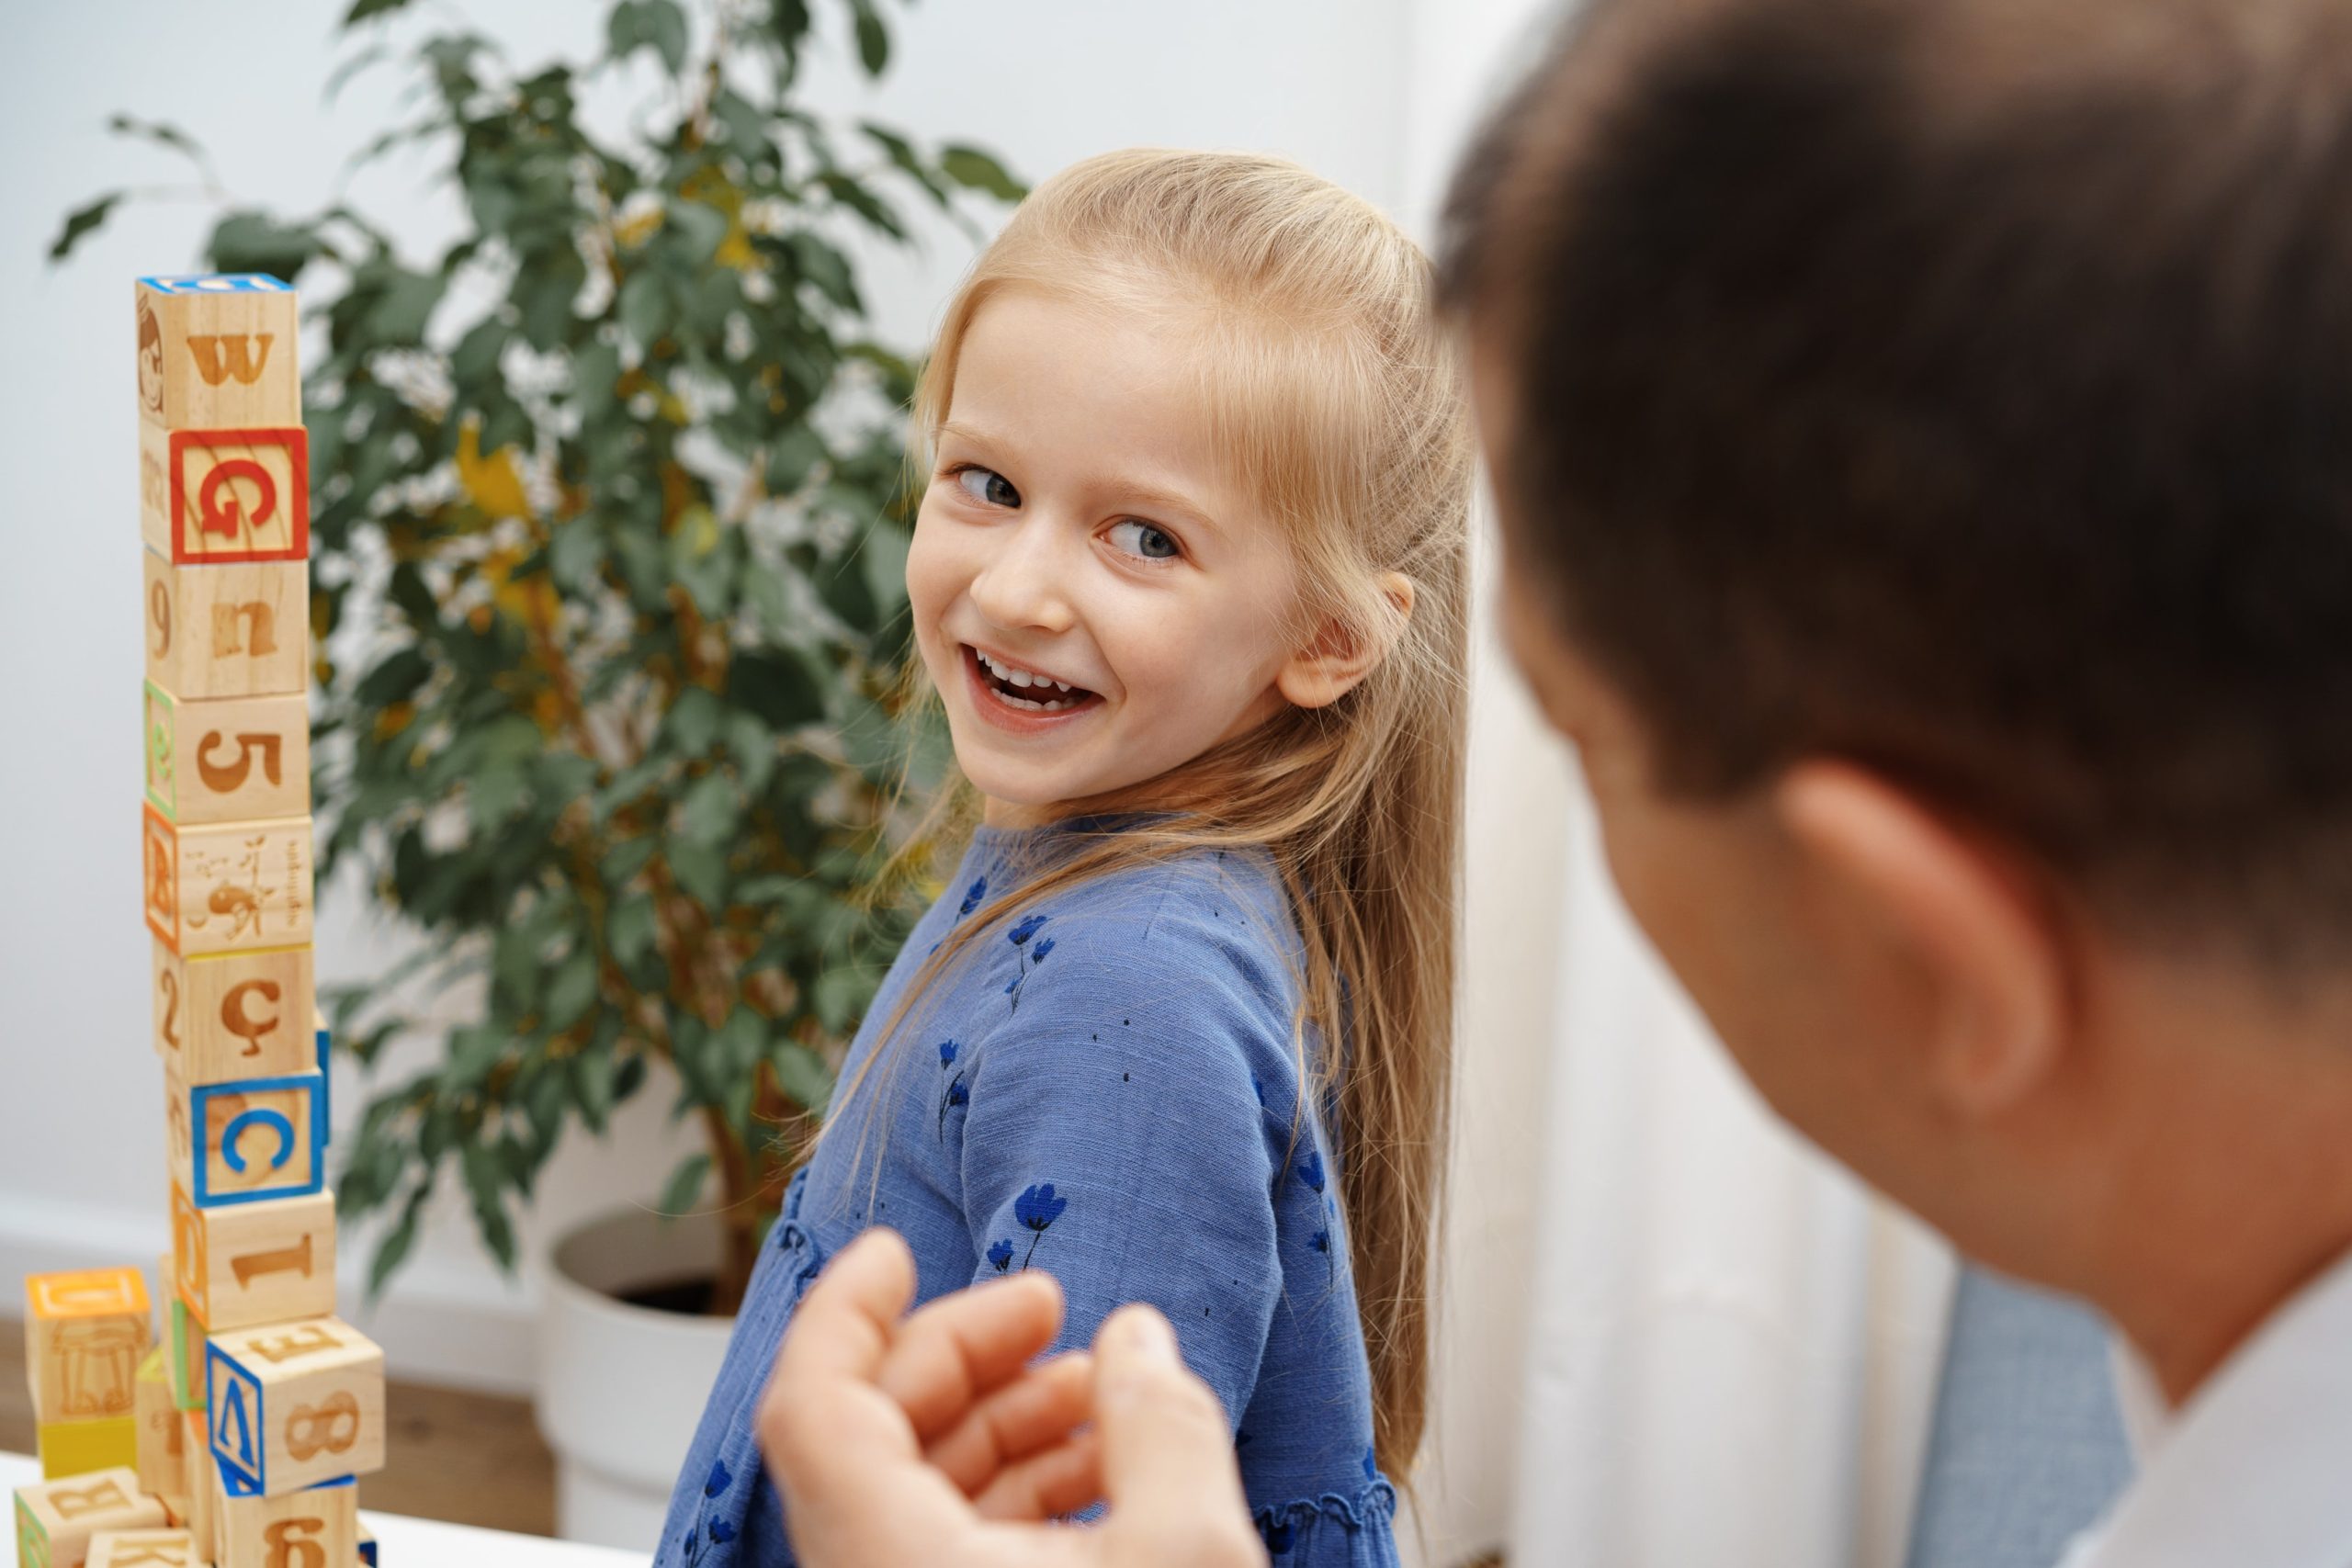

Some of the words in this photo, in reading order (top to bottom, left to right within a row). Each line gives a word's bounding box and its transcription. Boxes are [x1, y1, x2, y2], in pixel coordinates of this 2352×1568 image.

[187, 333, 274, 388] w
[198, 458, 277, 540] G
[196, 729, 282, 795] 5
[161, 967, 181, 1052] 2
[220, 1108, 295, 1174] C
[230, 1233, 313, 1292] 1
[246, 1325, 345, 1365] E
[284, 1390, 361, 1463] 8
